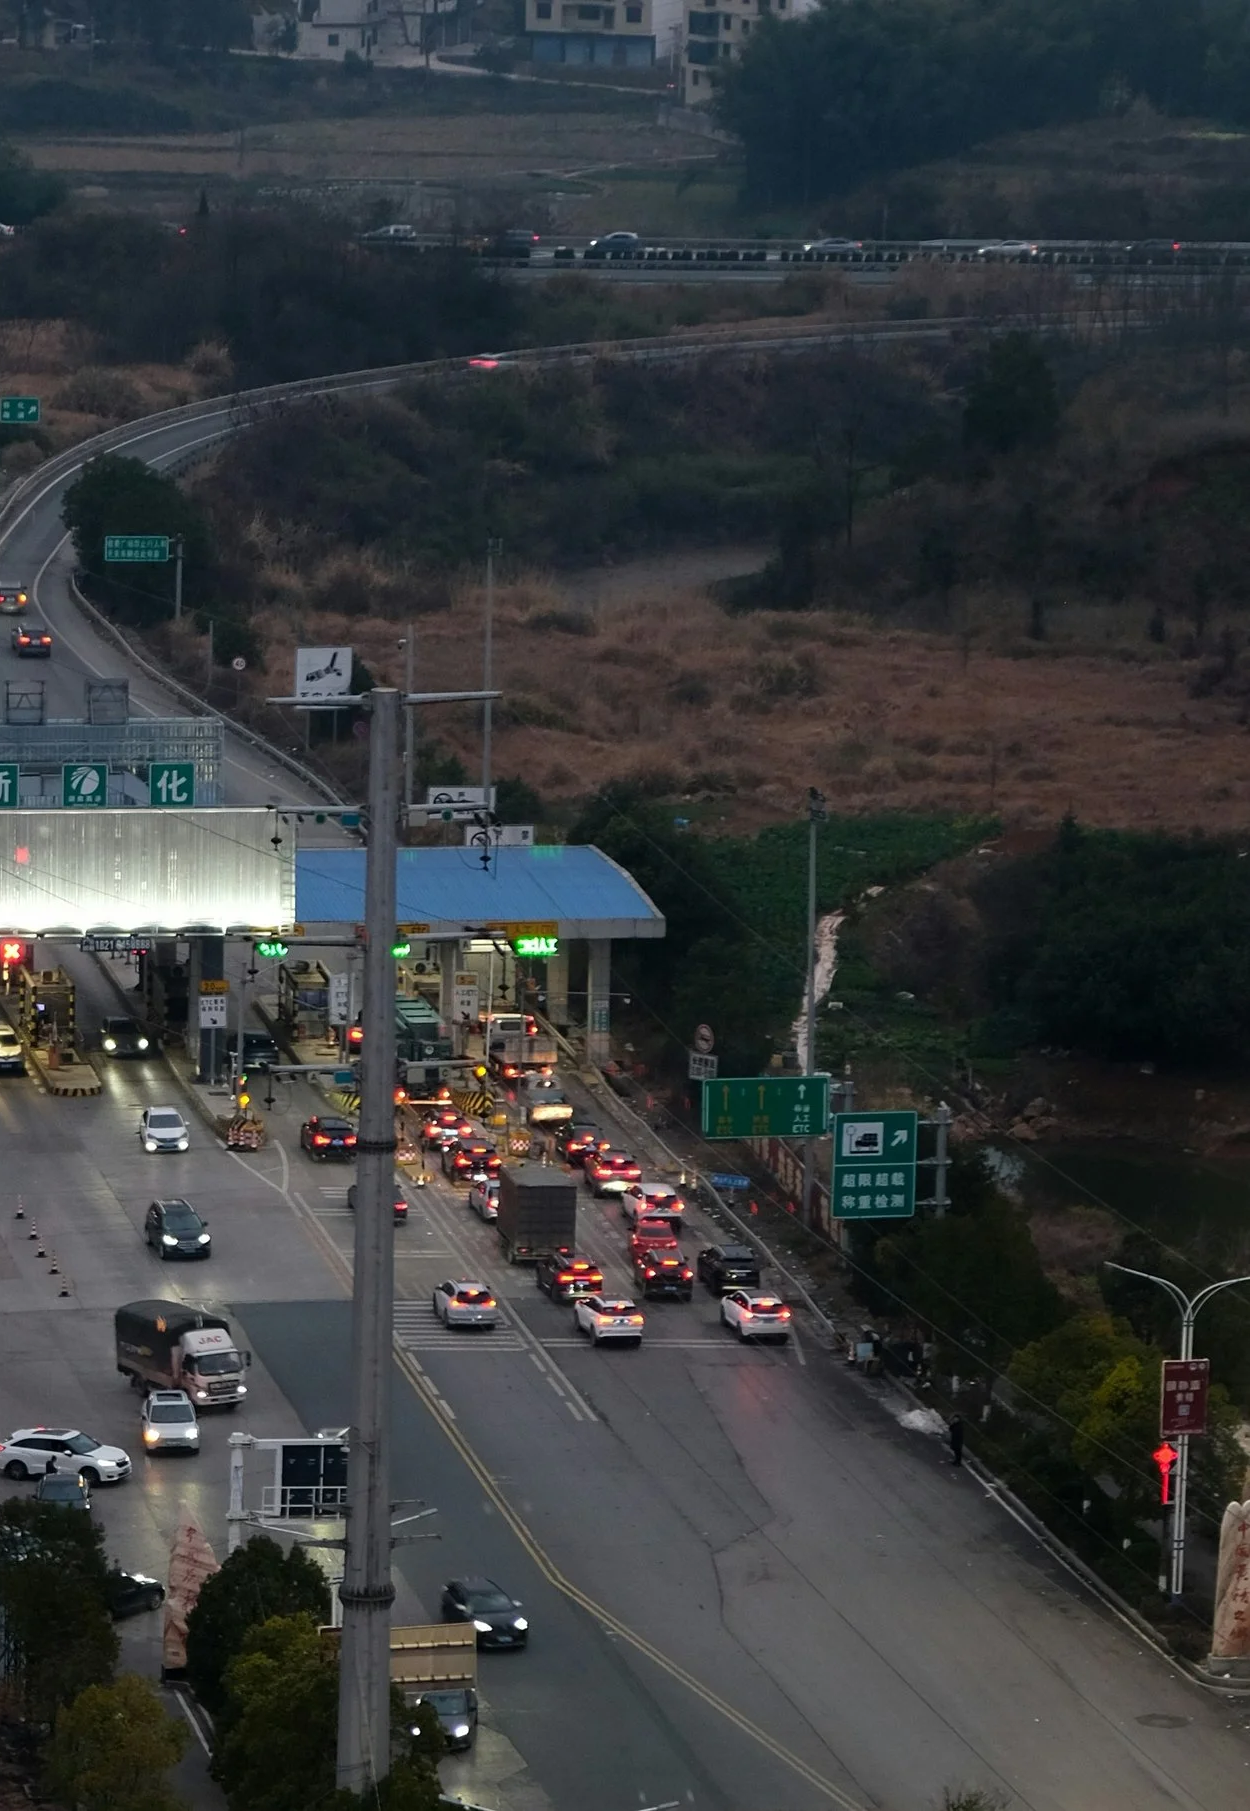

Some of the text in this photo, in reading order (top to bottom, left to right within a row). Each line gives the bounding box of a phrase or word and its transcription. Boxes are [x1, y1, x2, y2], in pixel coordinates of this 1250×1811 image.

[157, 770, 188, 803] 化
[793, 1113, 811, 1123] 人工
[791, 1124, 811, 1134] ETC
[842, 1172, 905, 1187] 超限超载
[841, 1194, 905, 1209] 称重检测
[198, 1335, 222, 1345] JAC
